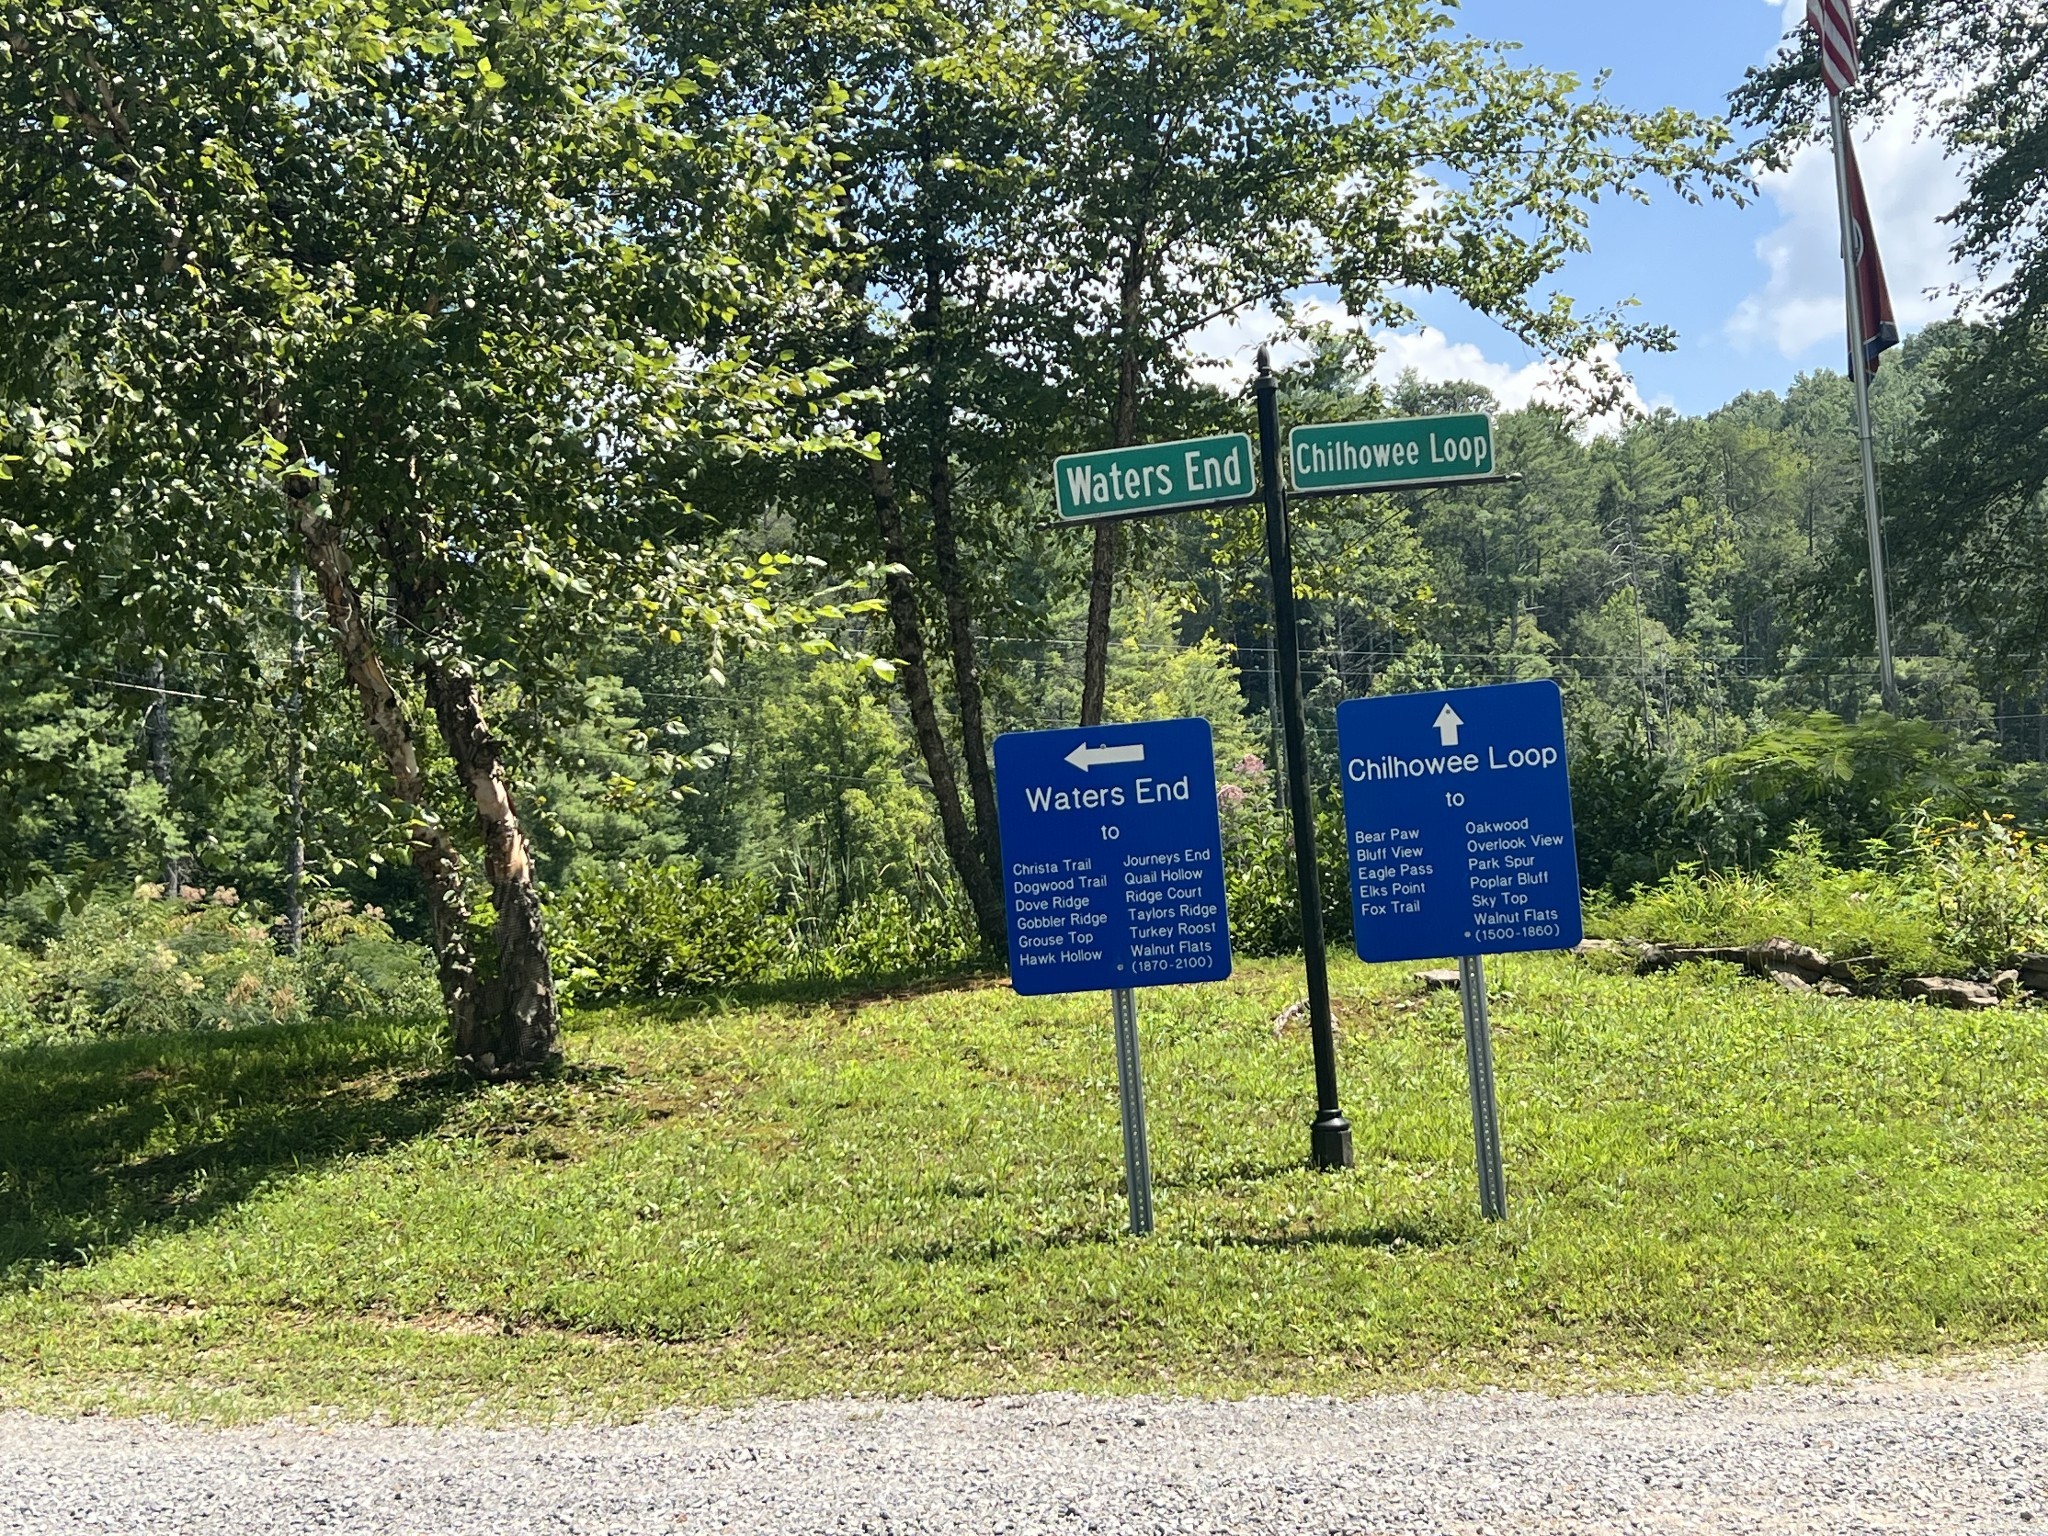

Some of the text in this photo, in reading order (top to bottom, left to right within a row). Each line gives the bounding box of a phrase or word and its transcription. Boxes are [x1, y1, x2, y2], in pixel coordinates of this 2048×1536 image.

[1296, 434, 1487, 474] Chilhowee Loop
[1067, 447, 1242, 506] Waters End
[1348, 746, 1557, 782] Chilhowee Loop
[1025, 776, 1189, 812] Waters End
[1445, 792, 1465, 807] to
[1101, 825, 1120, 840] to
[1466, 818, 1529, 834] Oakwood
[1355, 829, 1420, 843] Bear Paw
[1467, 834, 1564, 852] Overlook View
[1123, 849, 1210, 867] Journeys End
[1357, 846, 1423, 862] Bluff View
[1013, 858, 1091, 876] Christa Trail
[1469, 856, 1535, 870] Park Spur
[1124, 868, 1203, 885] Quail Hollow
[1359, 864, 1433, 881] Eagle Pass
[1470, 872, 1549, 890] Poplar Bluff
[1014, 876, 1107, 895] Dogwood Trail
[1360, 882, 1426, 898] Elks Point
[1016, 896, 1090, 912] Dove Ridge
[1126, 887, 1202, 904] Ridge Court
[1472, 892, 1528, 909] Sky Top
[1128, 904, 1217, 921] Taylors Ridge
[1362, 900, 1420, 916] Fox Trail
[1017, 913, 1108, 930] Gobbler Ridge
[1474, 909, 1558, 926] Walnut Flats
[1019, 931, 1094, 948] Grouse Top
[1130, 922, 1216, 940] Turkey Roost
[1475, 924, 1560, 942] (1500-1860)
[1131, 940, 1212, 957] Walnut Flats
[1020, 950, 1103, 966] Hawk Hollow
[1132, 956, 1213, 974] (1870-2100)
